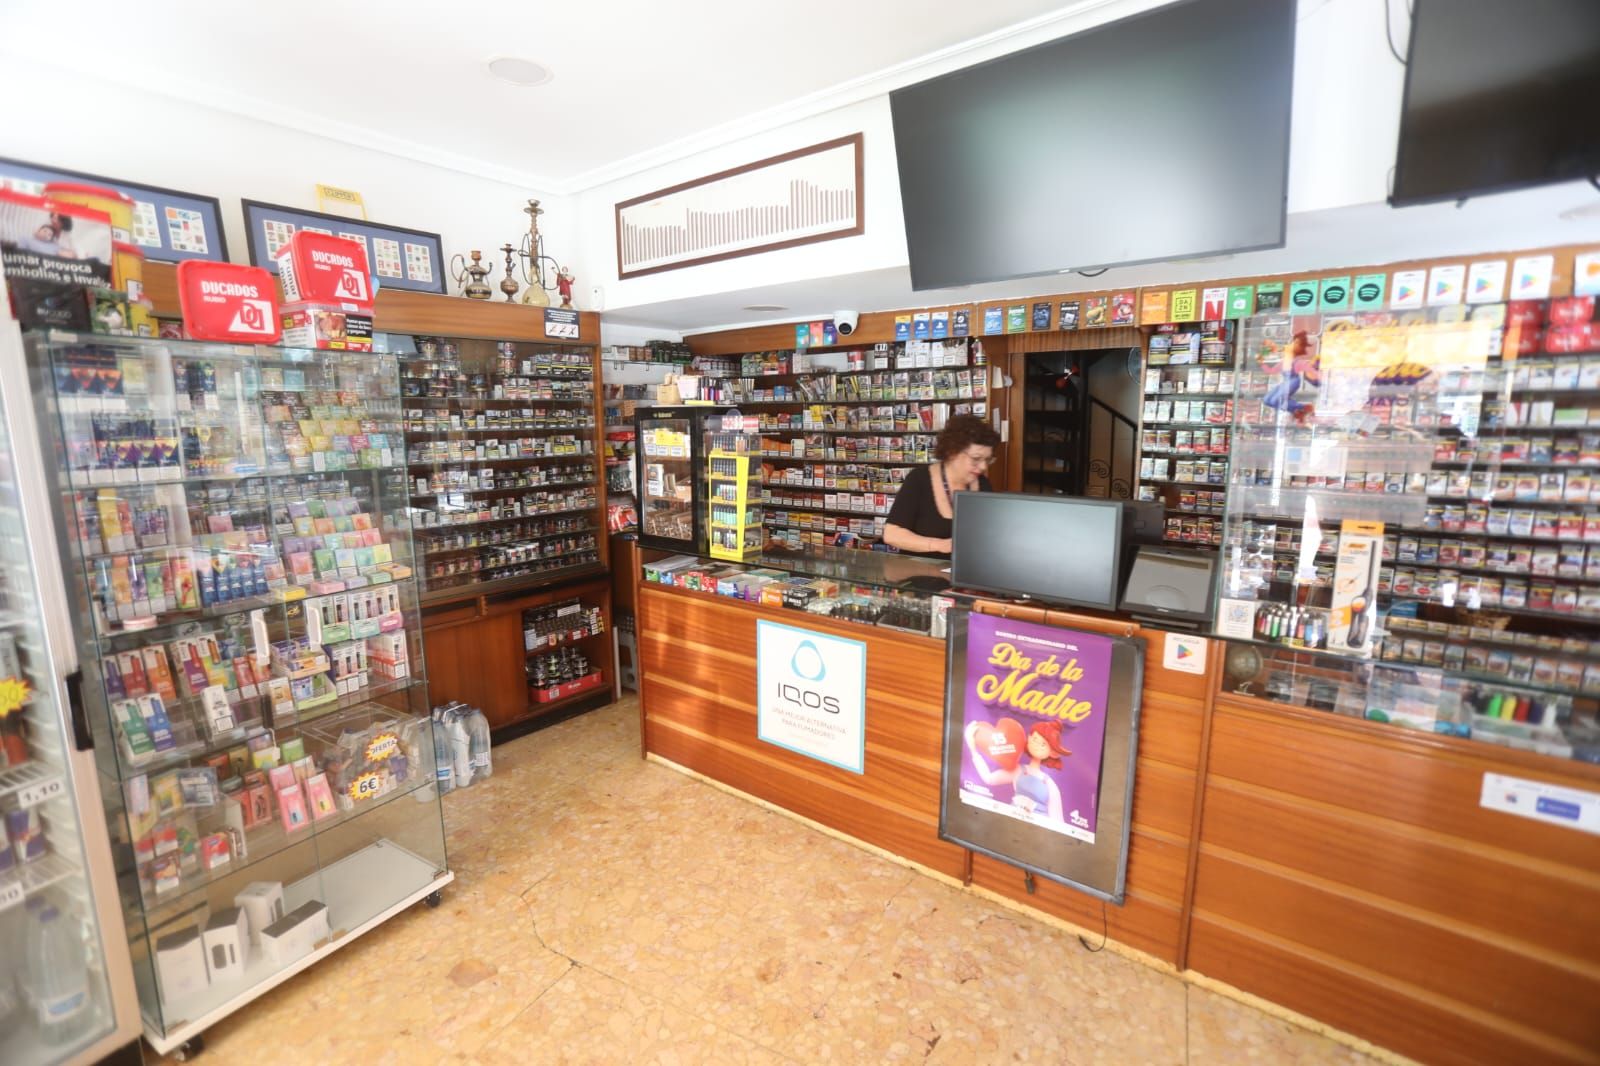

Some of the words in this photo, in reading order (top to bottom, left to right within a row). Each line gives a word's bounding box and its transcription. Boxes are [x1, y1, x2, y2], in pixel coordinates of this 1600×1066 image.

[3, 252, 39, 266] umar
[43, 258, 92, 274] provoca
[312, 250, 354, 268] DUCADOS
[201, 280, 259, 299] DUCADOS
[1035, 654, 1060, 676] de
[1060, 658, 1084, 682] la
[777, 682, 840, 714] IQOS
[976, 669, 1092, 723] Madre
[24, 782, 61, 801] 1,10
[359, 777, 377, 793] 6€
